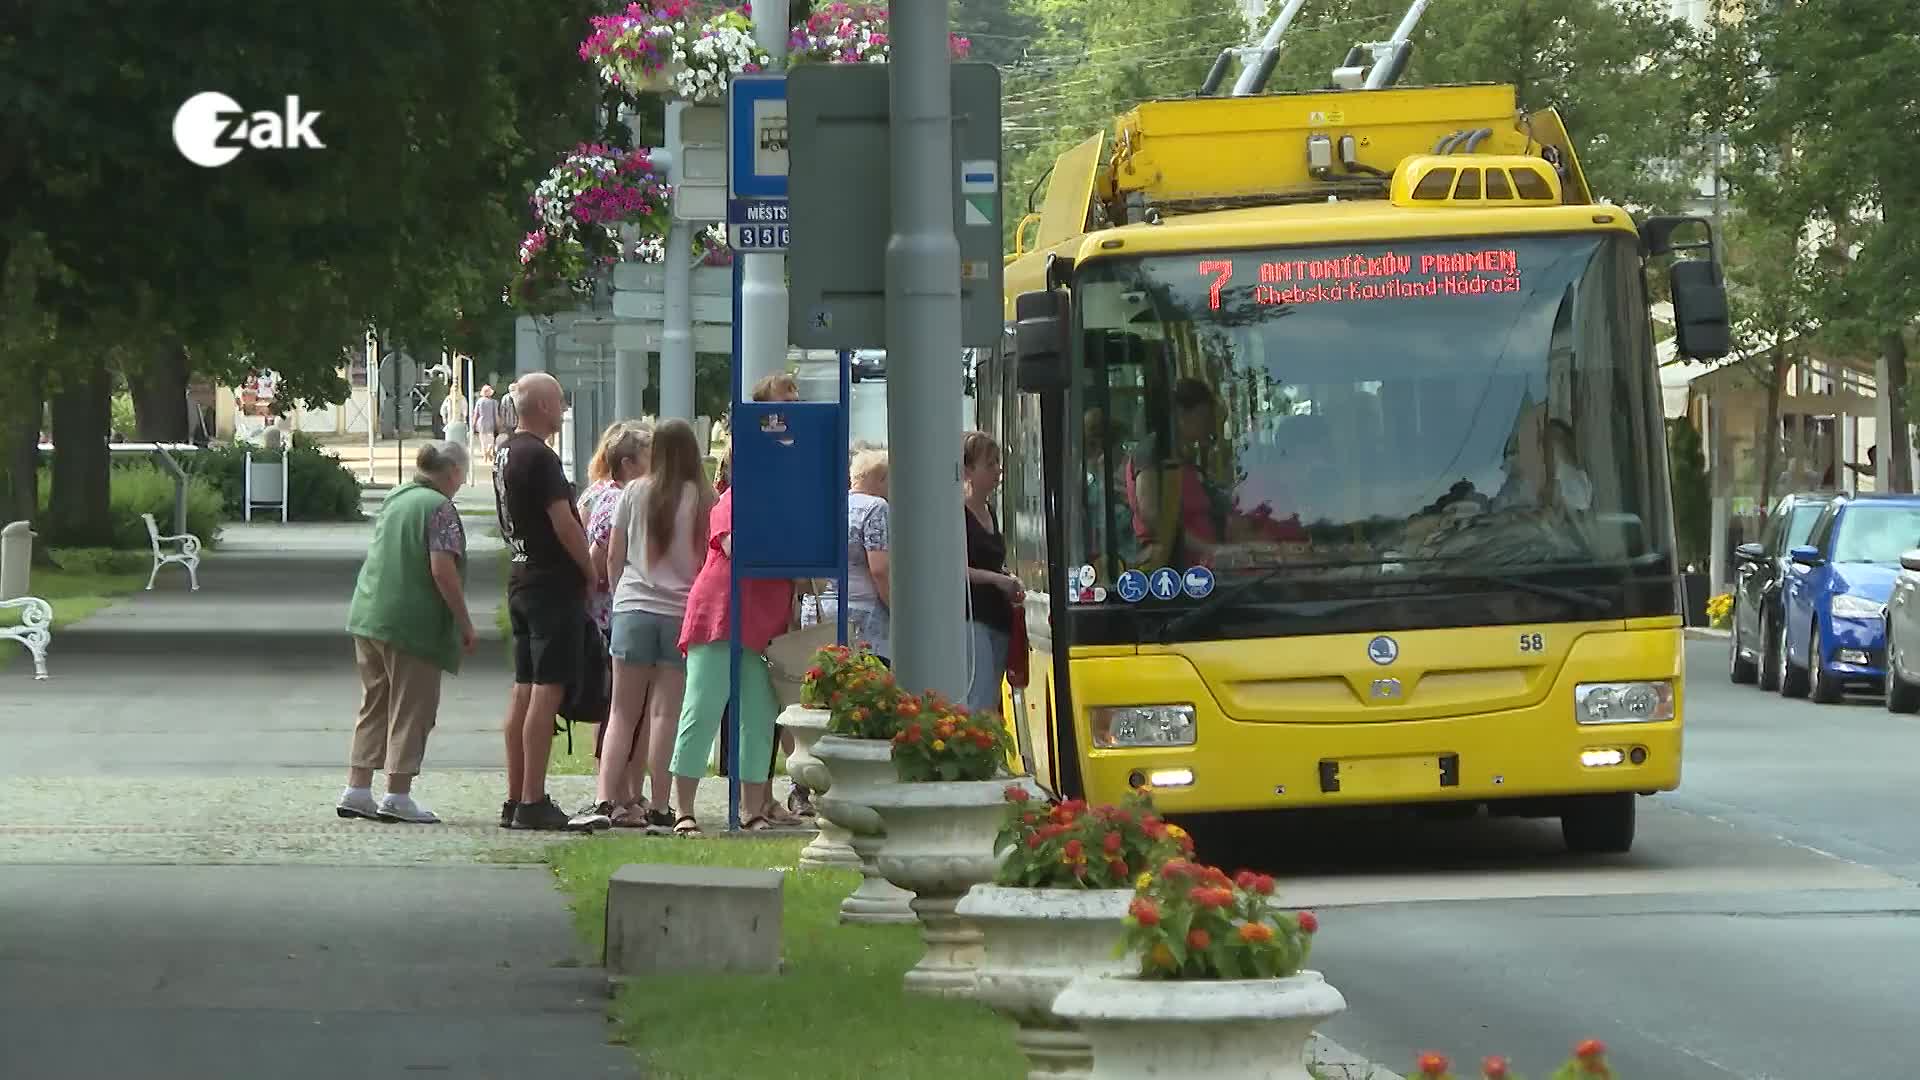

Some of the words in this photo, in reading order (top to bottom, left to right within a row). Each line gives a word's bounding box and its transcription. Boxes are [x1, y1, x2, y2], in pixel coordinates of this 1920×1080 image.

[743, 229, 753, 244] 3
[762, 229, 772, 244] 5
[1199, 258, 1233, 311] 7
[1421, 249, 1517, 275] PRAMEN
[1519, 633, 1544, 651] 58
